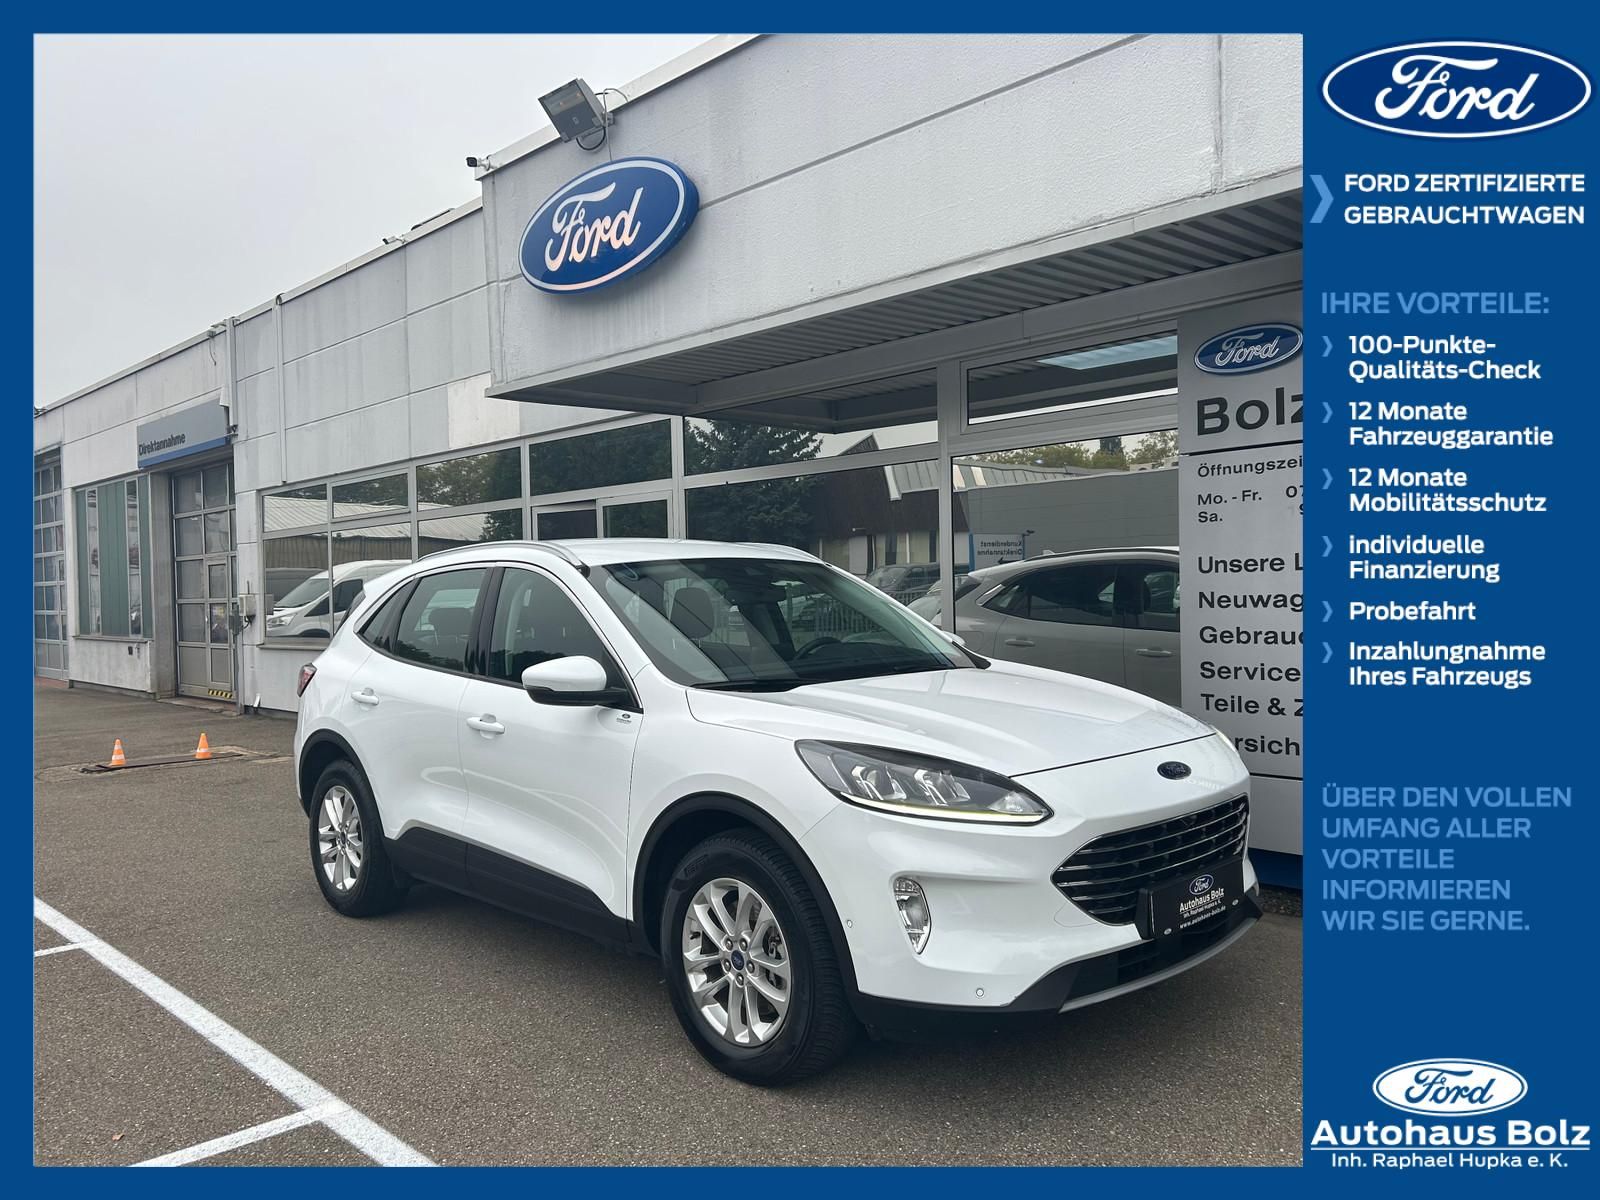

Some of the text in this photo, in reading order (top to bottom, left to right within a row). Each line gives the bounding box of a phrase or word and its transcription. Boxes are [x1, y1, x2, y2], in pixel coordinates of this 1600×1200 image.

[545, 182, 644, 271] Ford
[1214, 332, 1280, 367] Ford
[138, 432, 186, 457] Direktannahme
[1197, 455, 1303, 478] Öffnungszei
[1197, 493, 1228, 506] Mo.
[1242, 489, 1262, 502] Fr.
[1198, 510, 1223, 523] Sa.
[1198, 554, 1285, 574] Unsere
[1198, 591, 1303, 613] Neuwag
[1200, 661, 1301, 682] Service
[1200, 692, 1260, 715] Teile
[1267, 697, 1287, 716] &
[1234, 735, 1300, 756] rsich
[1179, 887, 1225, 912] Autohaus Bolz
